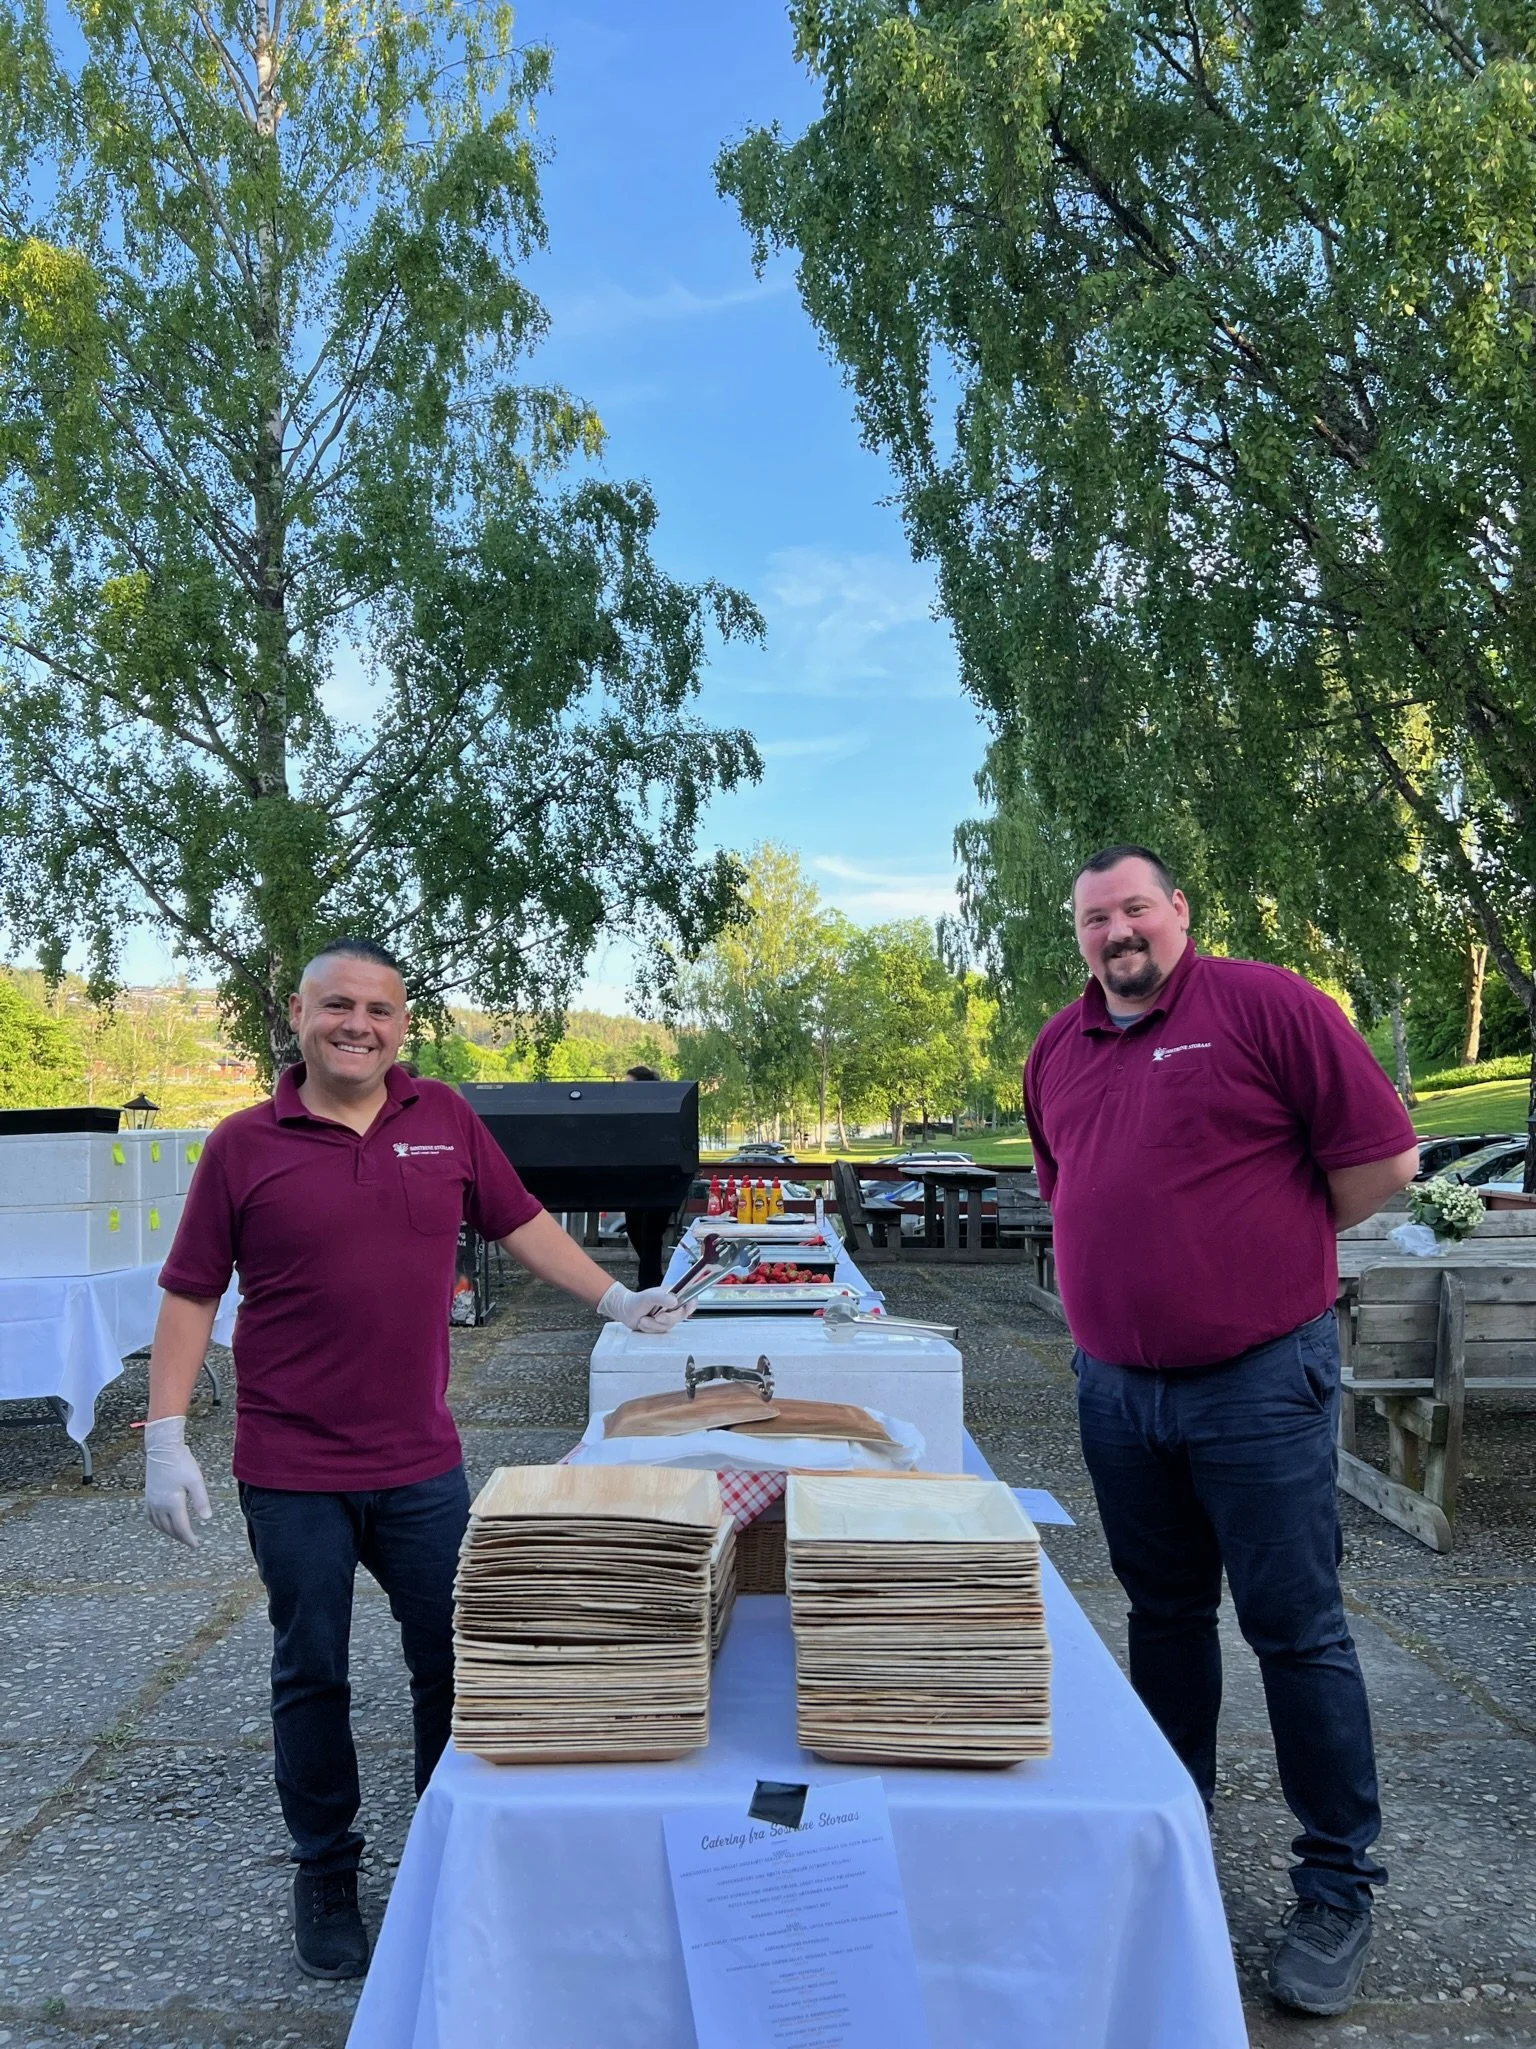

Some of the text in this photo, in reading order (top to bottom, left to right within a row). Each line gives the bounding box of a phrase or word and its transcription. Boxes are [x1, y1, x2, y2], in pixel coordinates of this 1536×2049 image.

[701, 1833, 746, 1850] Catering
[749, 1827, 765, 1844] fra
[818, 1811, 860, 1828] Storaas
